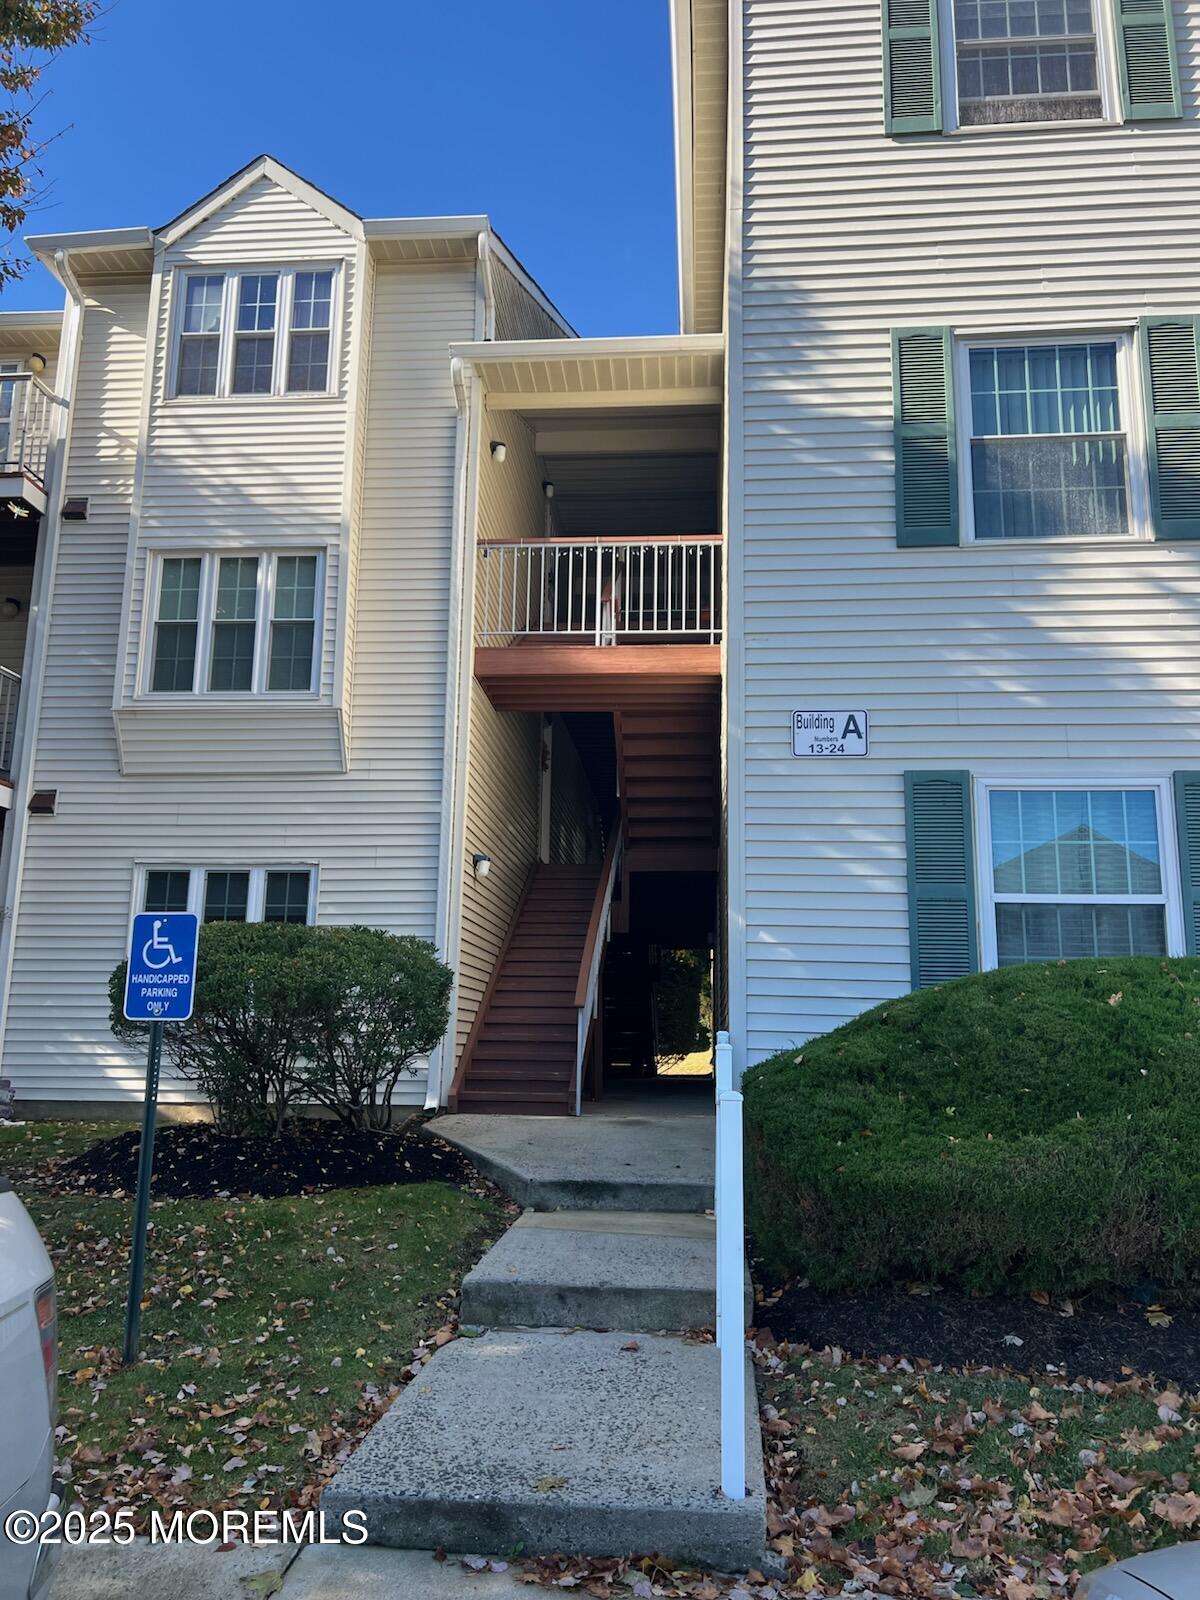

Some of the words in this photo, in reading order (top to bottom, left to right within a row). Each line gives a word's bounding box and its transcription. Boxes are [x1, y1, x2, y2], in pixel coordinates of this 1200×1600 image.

[796, 714, 835, 733] Building
[841, 714, 863, 739] A
[809, 744, 845, 753] 13-24
[131, 974, 190, 984] HANDICAPPED
[140, 988, 178, 997] PARKING
[147, 1001, 170, 1012] ONLY
